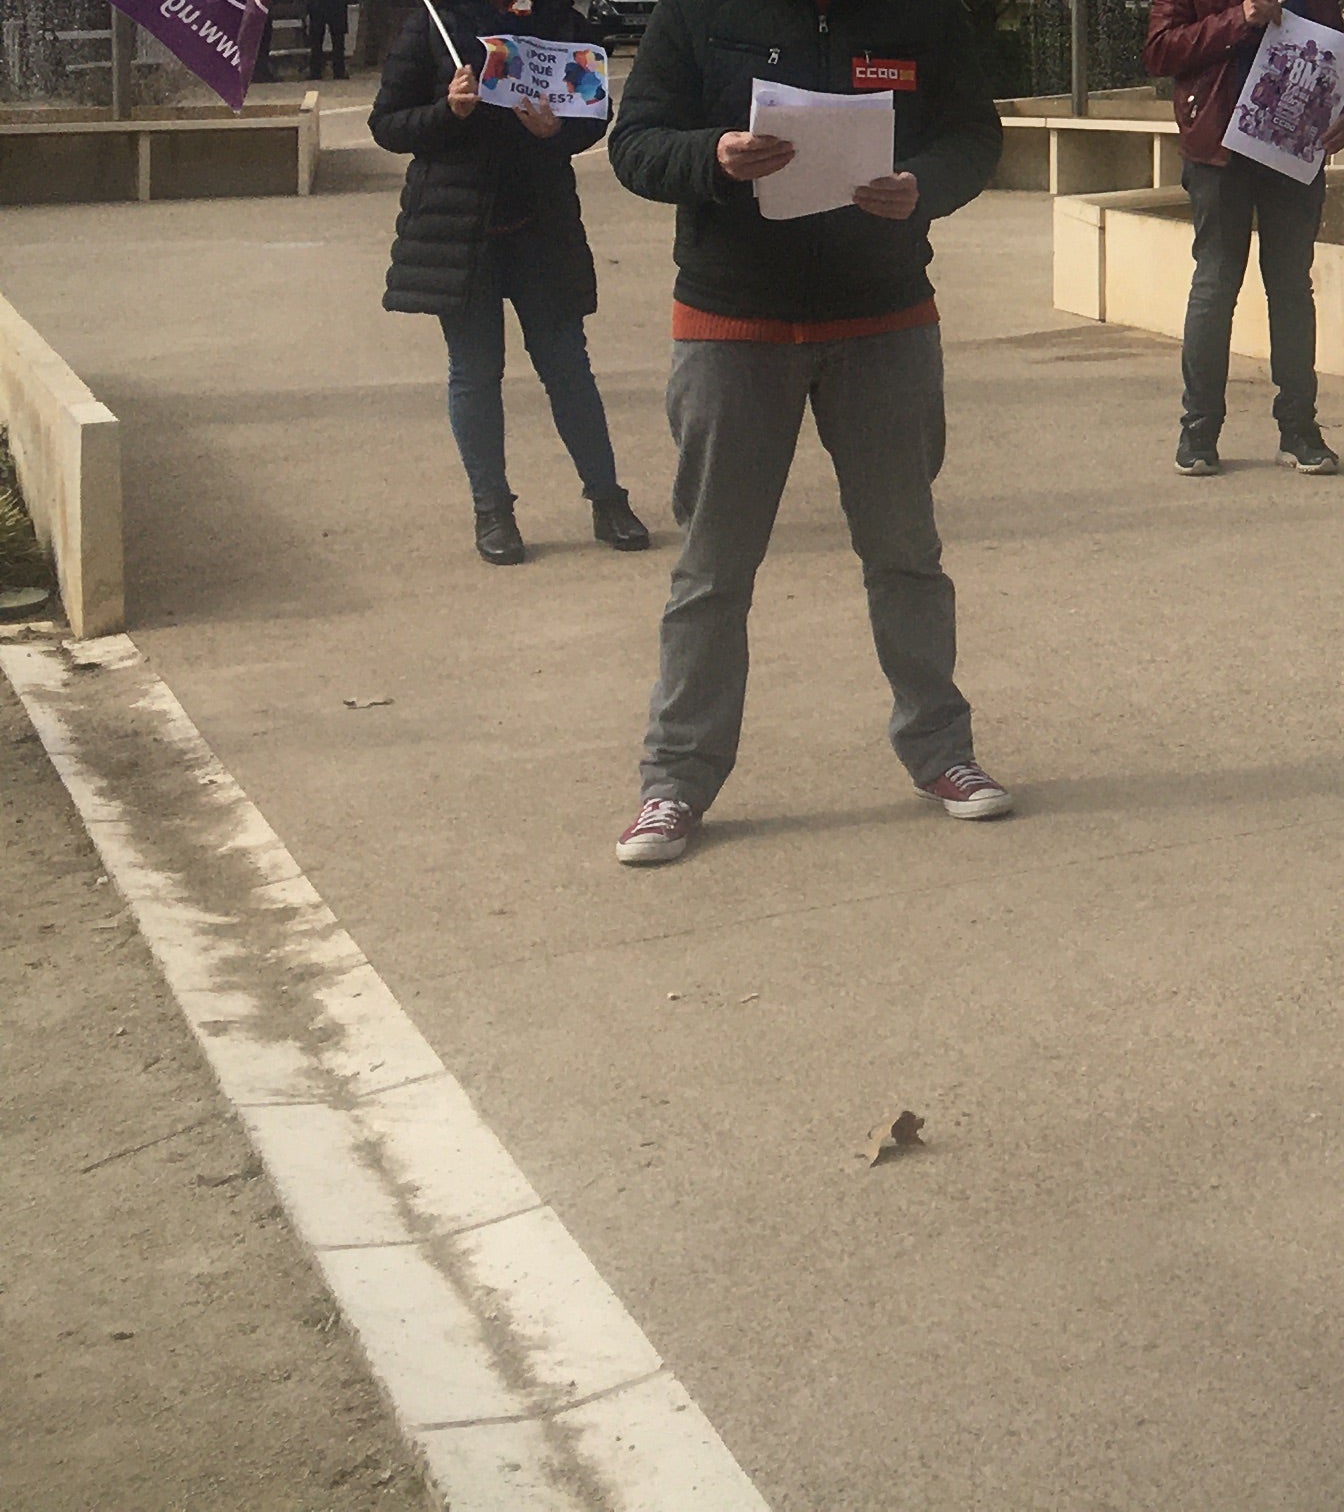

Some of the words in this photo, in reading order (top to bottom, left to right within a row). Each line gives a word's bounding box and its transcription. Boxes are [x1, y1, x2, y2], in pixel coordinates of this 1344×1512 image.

[528, 62, 553, 77] QUÉ
[855, 67, 898, 80] CCOO
[531, 76, 550, 89] NO
[510, 82, 574, 104] IGUAES?
